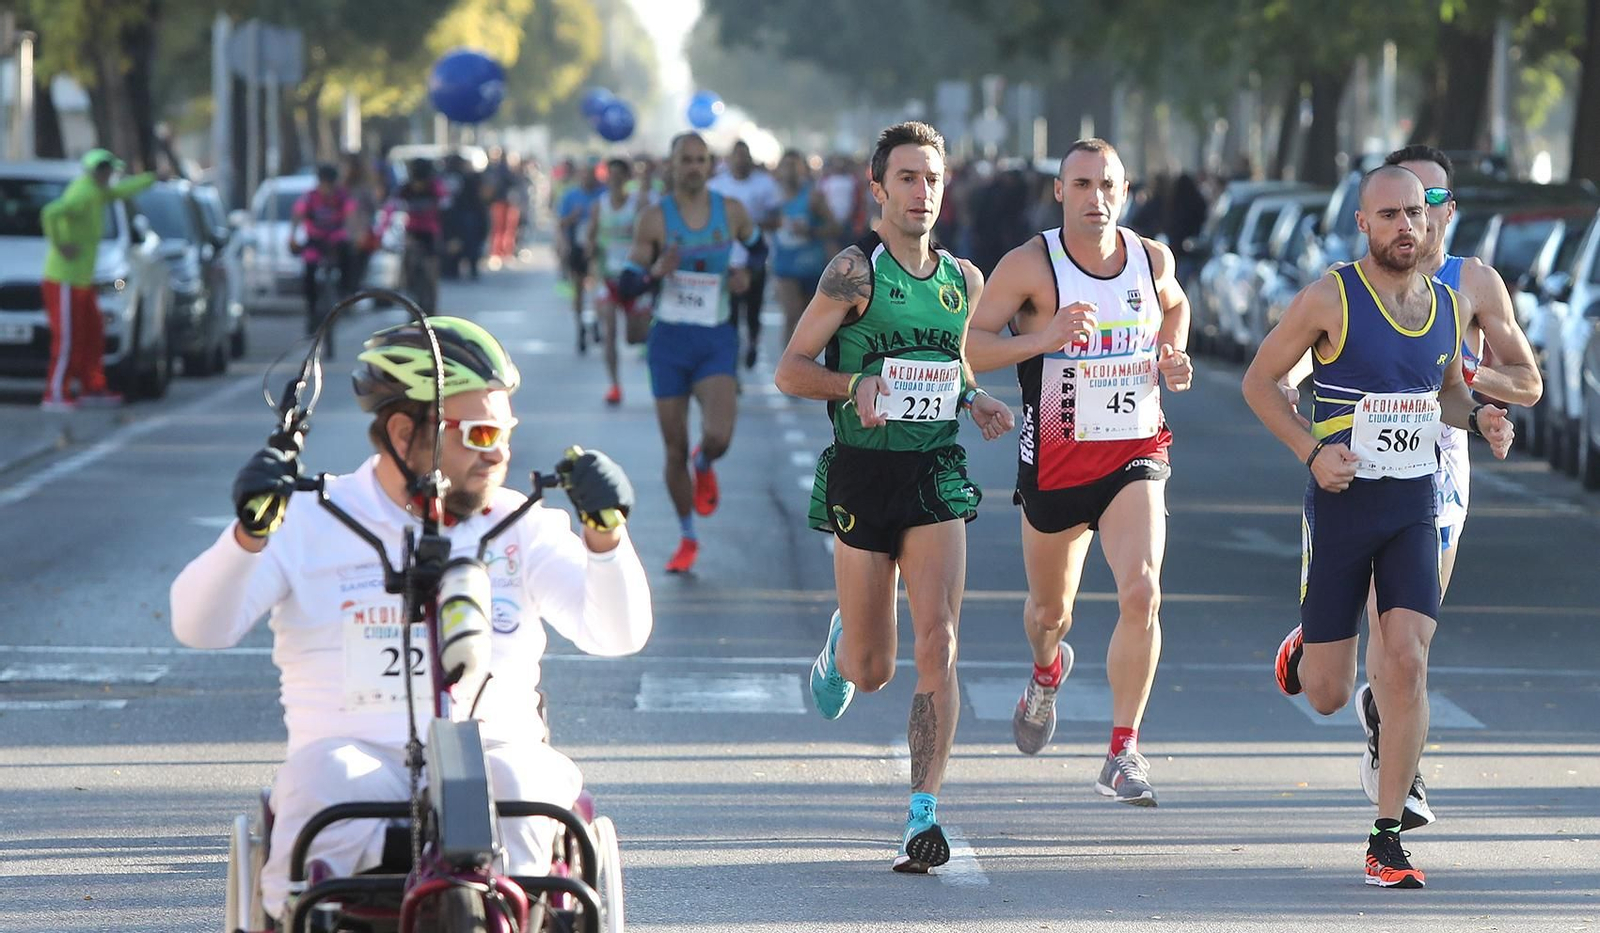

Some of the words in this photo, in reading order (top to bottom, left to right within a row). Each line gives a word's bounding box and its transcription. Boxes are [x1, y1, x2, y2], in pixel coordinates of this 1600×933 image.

[865, 330, 906, 352] VIA
[894, 380, 923, 391] CIUDAD
[926, 382, 935, 392] DE
[1089, 378, 1117, 388] CIUDAD
[1121, 377, 1129, 386] DE
[901, 396, 941, 420] 223
[1106, 391, 1136, 414] 45
[1368, 413, 1398, 423] CIUDAD
[1401, 414, 1411, 423] DE
[1414, 412, 1434, 423] JEREZ
[1376, 427, 1423, 453] 586
